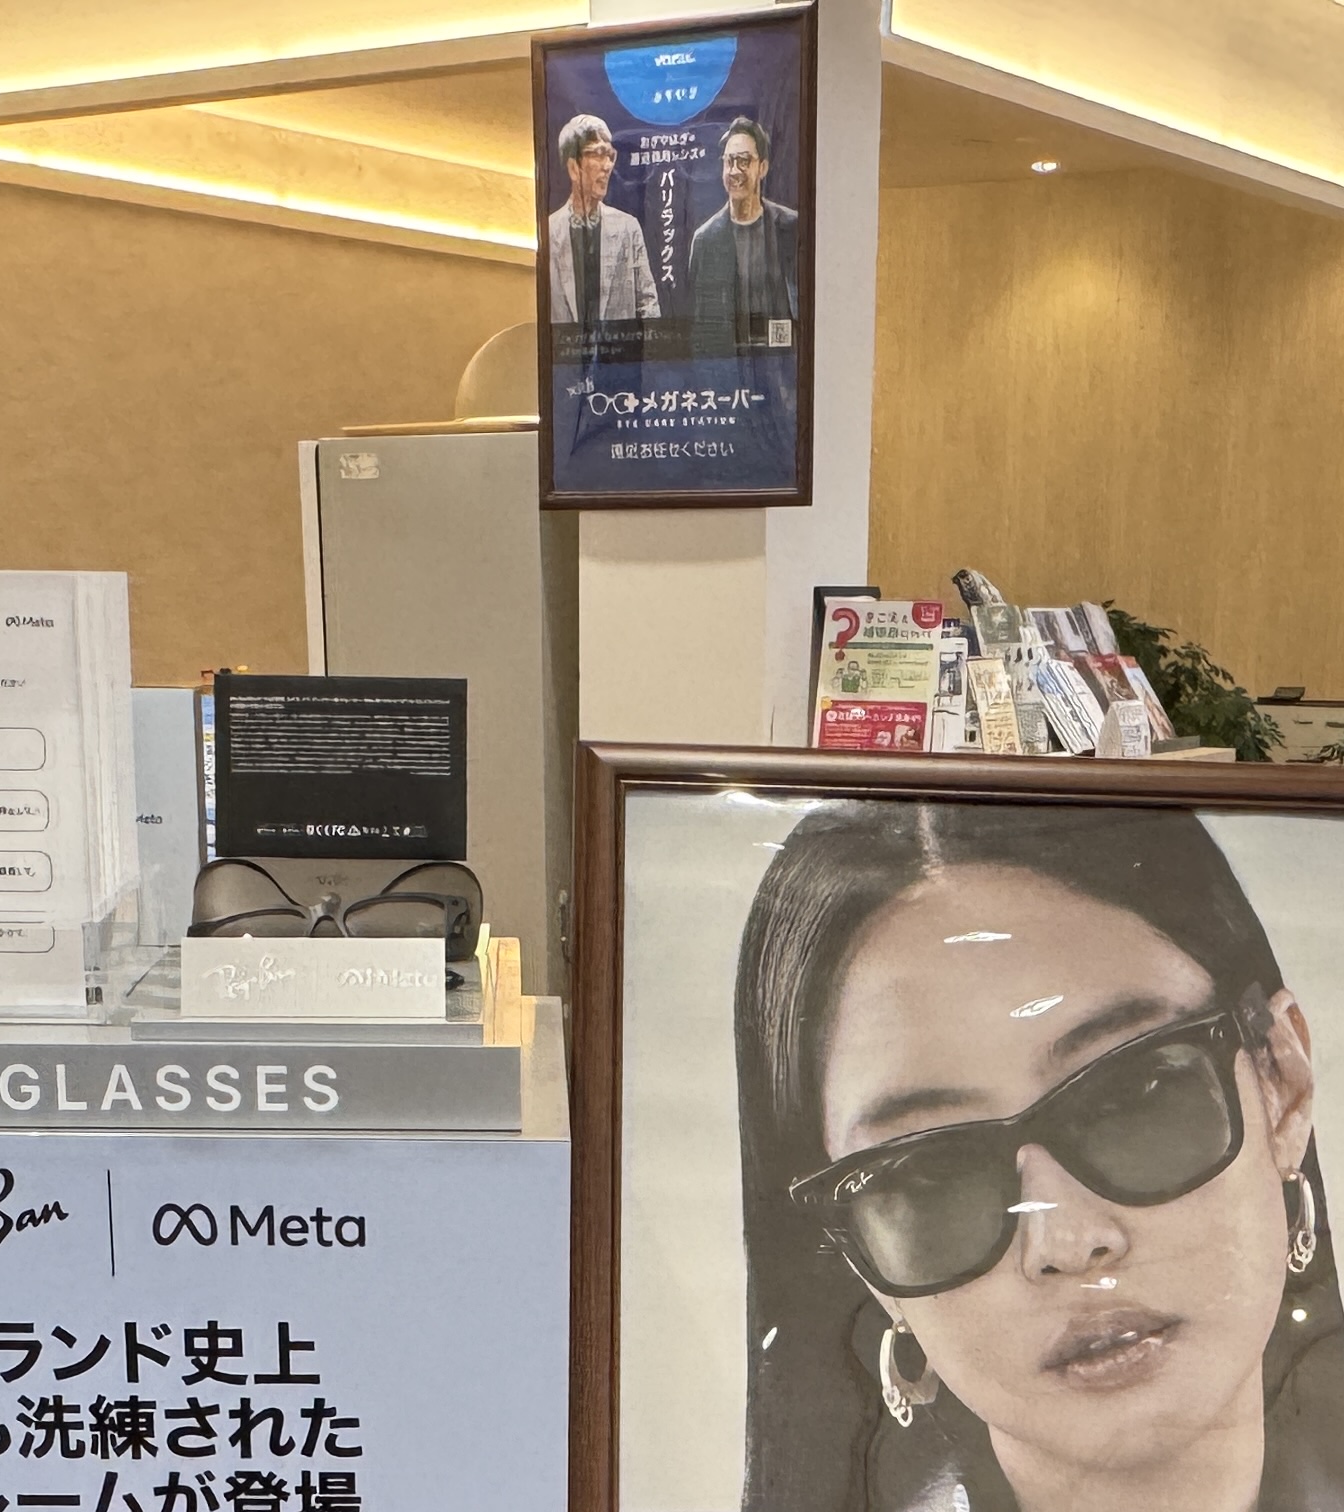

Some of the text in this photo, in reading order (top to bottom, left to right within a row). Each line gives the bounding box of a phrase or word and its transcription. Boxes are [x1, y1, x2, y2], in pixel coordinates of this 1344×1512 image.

[641, 389, 766, 413] メガネスーパー
[0, 1063, 340, 1112] GLASSES
[229, 1204, 367, 1249] Meta
